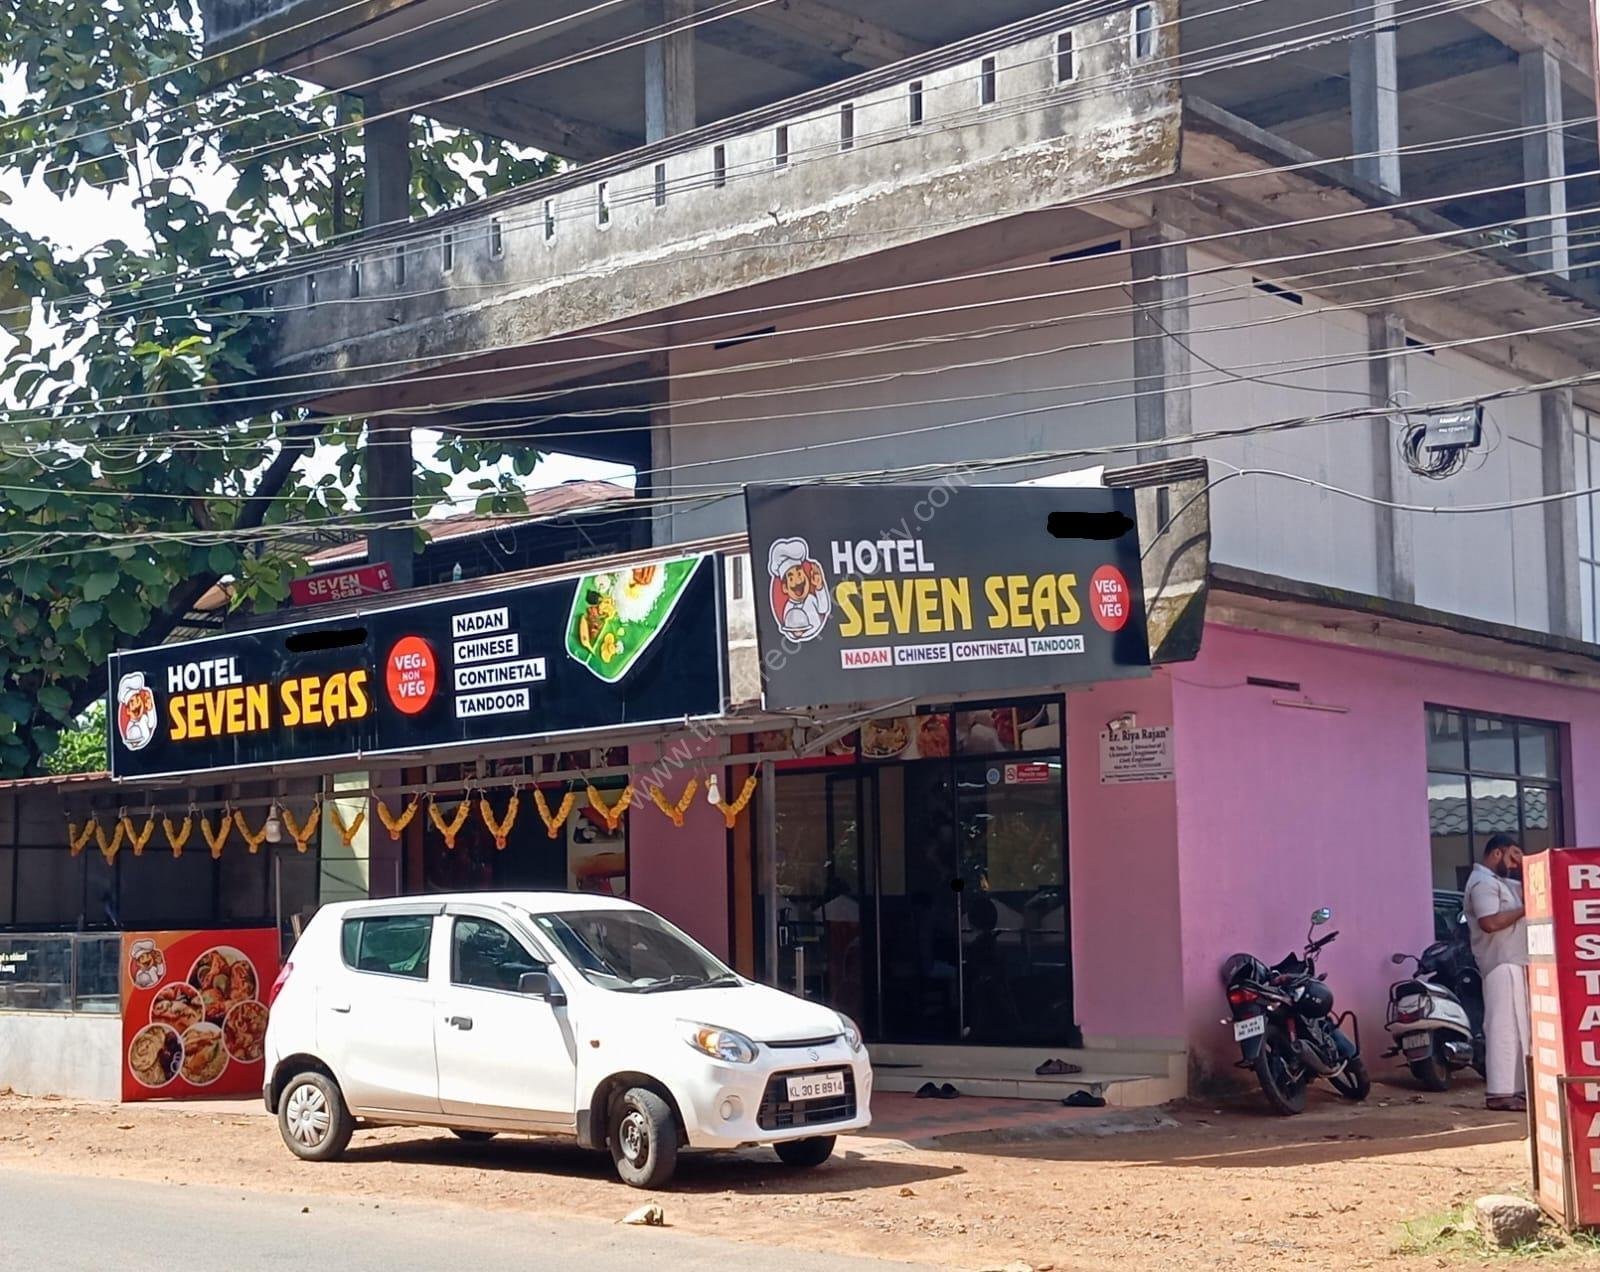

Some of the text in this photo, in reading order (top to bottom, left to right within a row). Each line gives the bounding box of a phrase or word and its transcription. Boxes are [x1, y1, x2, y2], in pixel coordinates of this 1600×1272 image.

[831, 539, 935, 574] HOTEL
[308, 573, 360, 595] SEVEN
[834, 573, 1081, 637] SEVEN SEAS
[1101, 594, 1117, 603] NON
[1099, 603, 1122, 617] VEG
[457, 612, 503, 632] NADAN
[458, 639, 513, 659] CHINESE
[844, 639, 1082, 665] NADAN CHINESE CONTINETAL TANDOOR
[168, 656, 243, 693] HOTEL
[401, 671, 420, 681] NON
[459, 663, 542, 686] CONTINETAL
[398, 680, 426, 698] VEG
[169, 670, 368, 741] SEVEN SEAS
[460, 693, 525, 713] TANDOOR
[1568, 864, 1600, 1190] RESTAU
[789, 1081, 843, 1097] KL 30 E 8914
